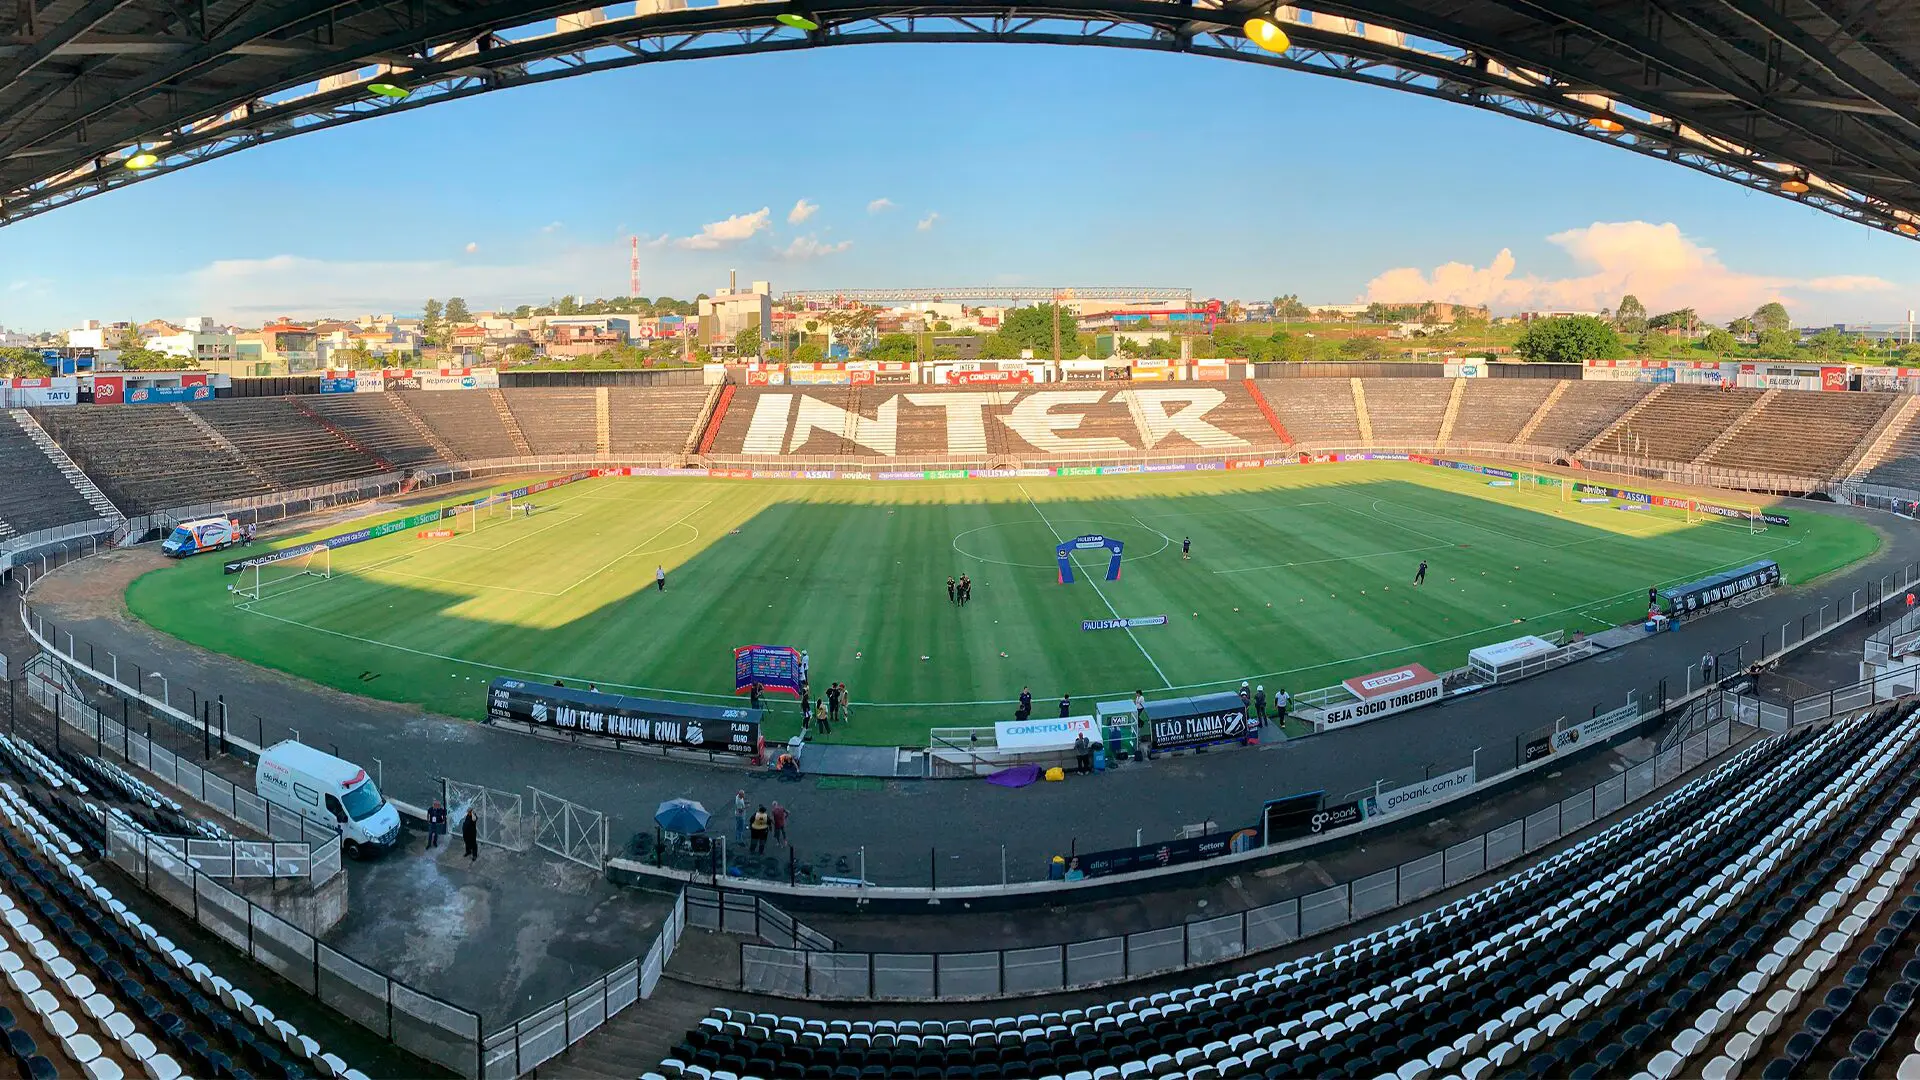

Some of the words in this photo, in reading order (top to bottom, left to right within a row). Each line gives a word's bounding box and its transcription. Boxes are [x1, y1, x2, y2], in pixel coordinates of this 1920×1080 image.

[47, 392, 70, 400] TATU
[740, 388, 1252, 456] INTER
[1071, 467, 1096, 476] Sicredi
[1196, 463, 1216, 471] CLEAR
[604, 468, 623, 477] Swift
[841, 472, 872, 480] novibet
[937, 470, 963, 478] Sicredi
[1582, 486, 1607, 496] novibet
[1701, 503, 1739, 517] PAYBROKERS
[419, 510, 440, 524] Sicredi
[381, 519, 406, 534] Sicredi
[494, 689, 510, 699] PLANO
[493, 699, 509, 709] PRETO
[1327, 707, 1352, 724] SEJA
[1356, 698, 1386, 716] SÓCIO
[1390, 686, 1438, 707] TORCEDOR
[556, 703, 576, 728] NÃO
[580, 710, 604, 732] TEME
[607, 714, 650, 740] NENHUM
[655, 719, 683, 743] RIVAL
[730, 722, 750, 732] PLANO
[1155, 719, 1182, 738] LEÃO
[1186, 715, 1223, 733] MANIA
[732, 734, 748, 743] OURO
[1198, 841, 1225, 852] Settore
